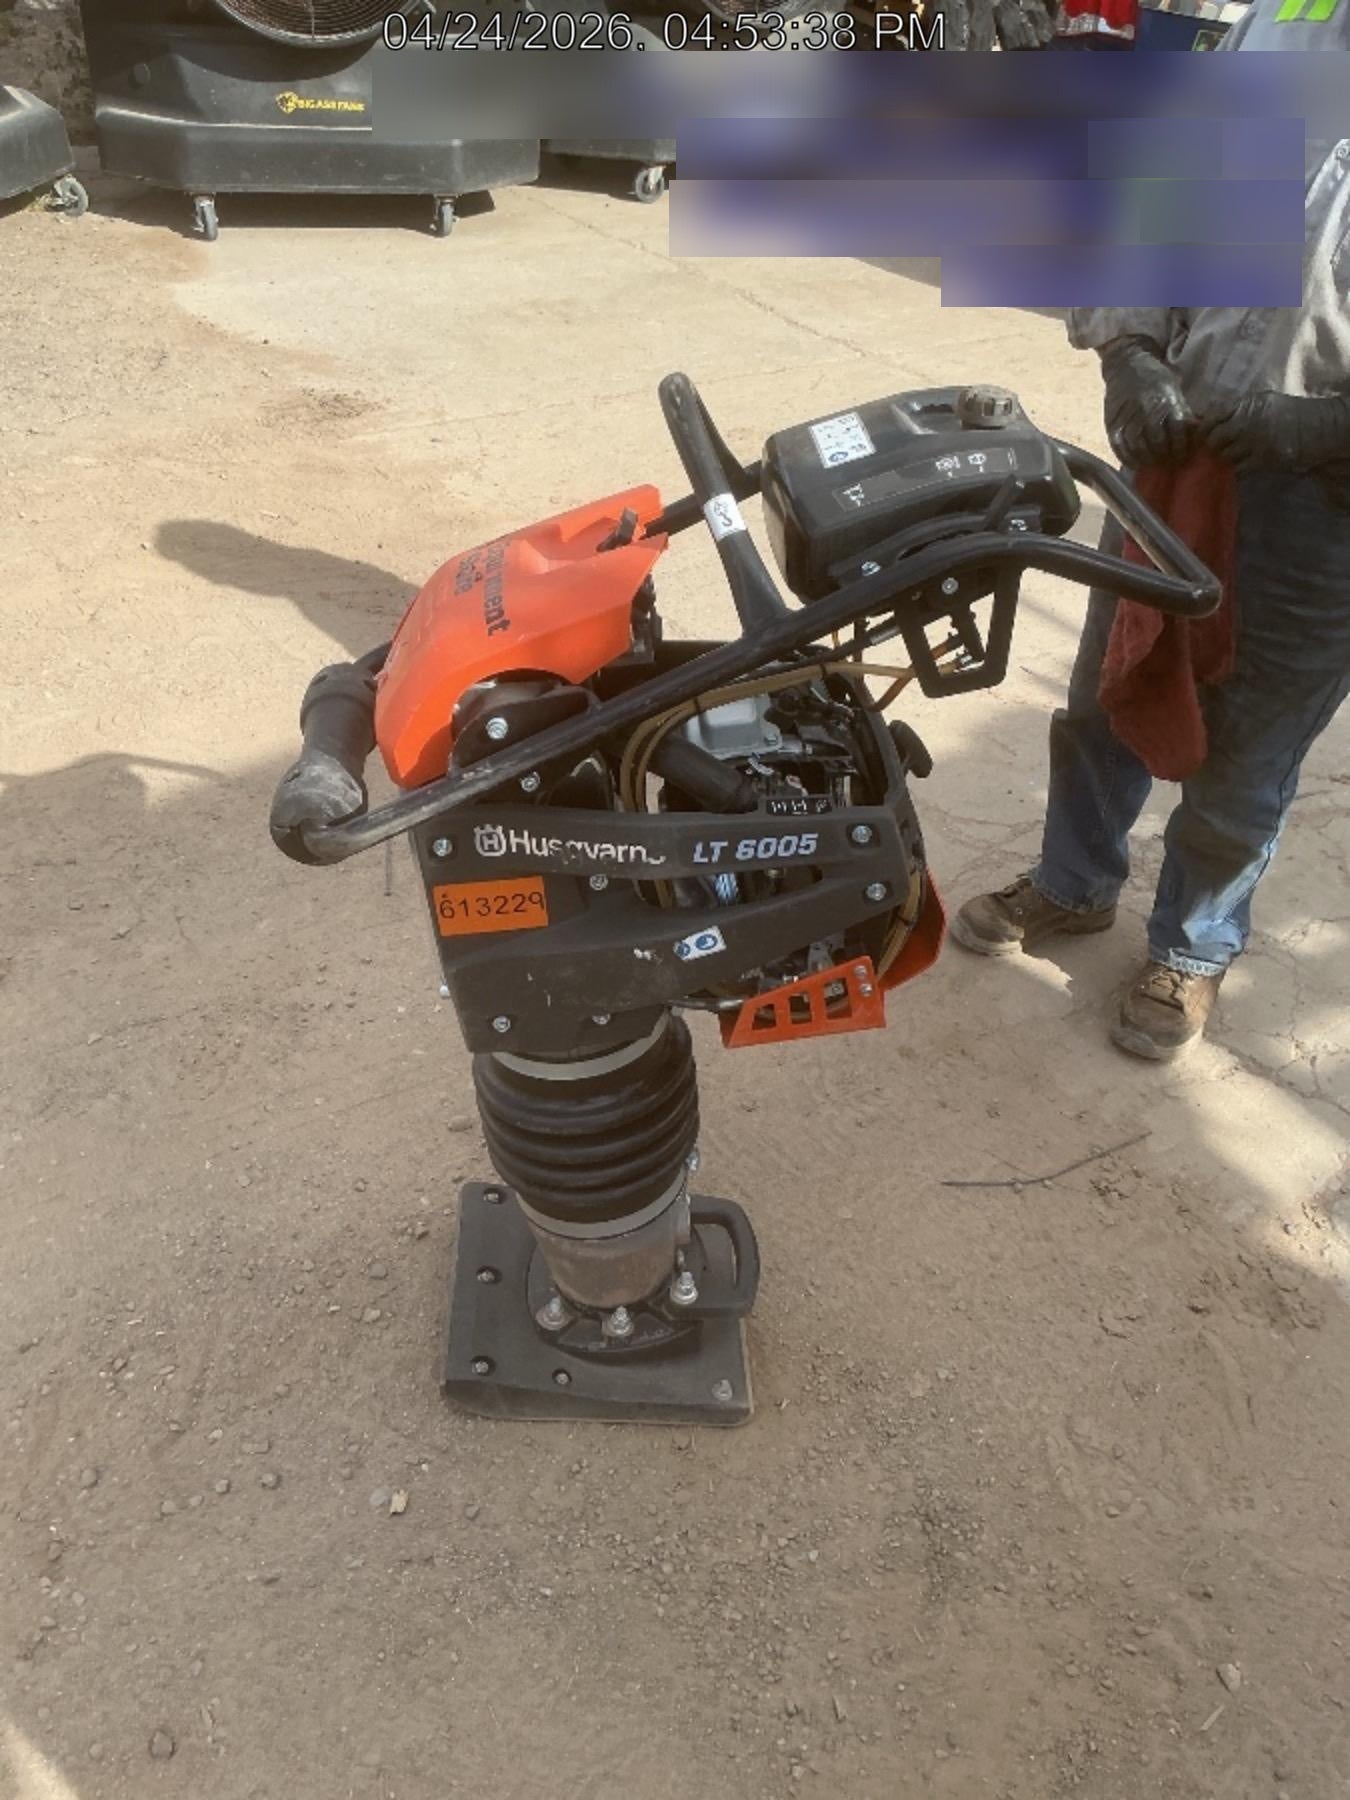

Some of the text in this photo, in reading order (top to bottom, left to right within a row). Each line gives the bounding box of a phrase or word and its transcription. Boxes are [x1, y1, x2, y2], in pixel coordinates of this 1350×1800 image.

[693, 833, 819, 863] LT 6005
[440, 891, 545, 919] 613229
